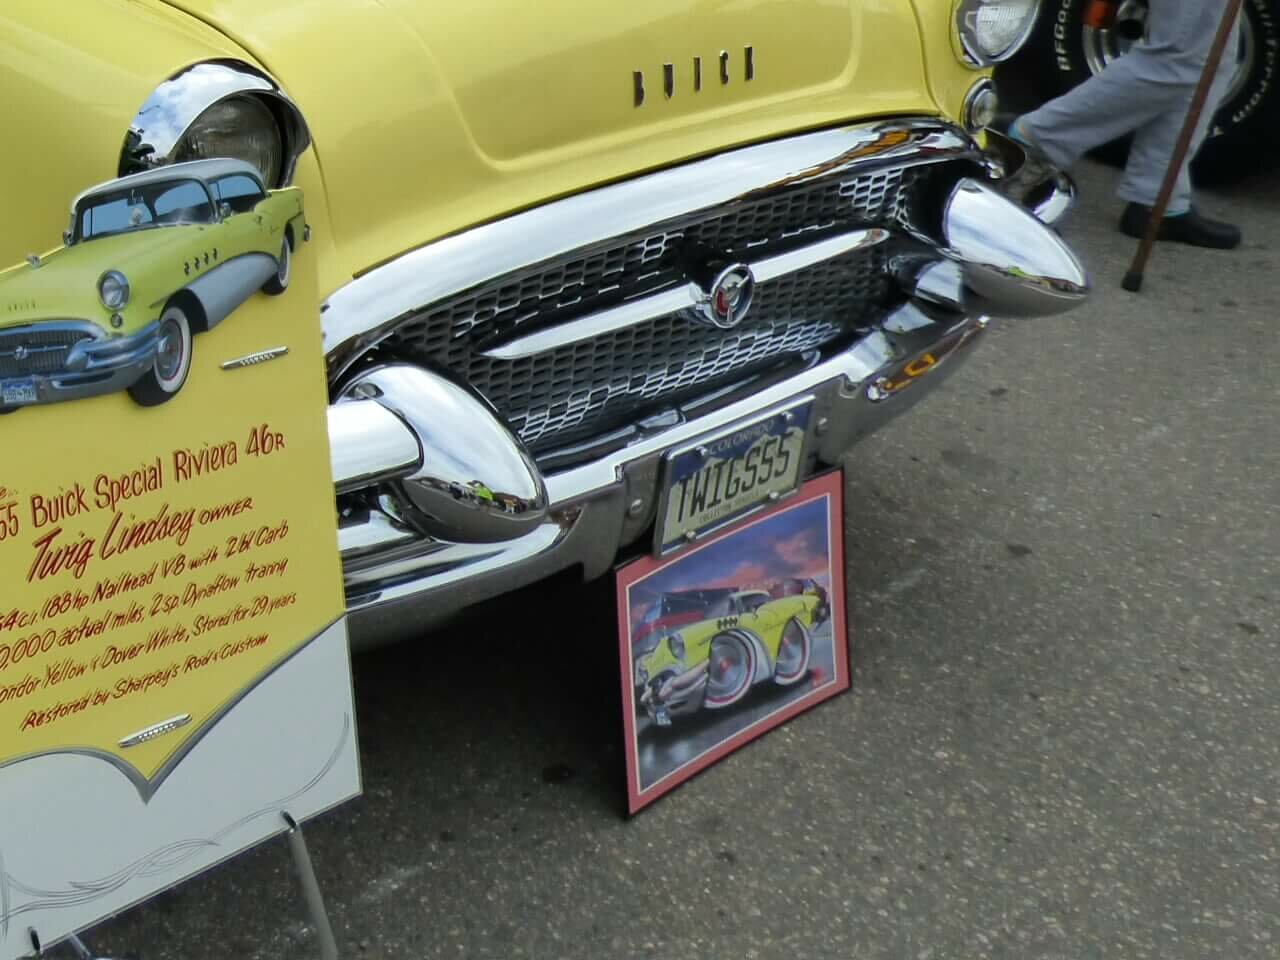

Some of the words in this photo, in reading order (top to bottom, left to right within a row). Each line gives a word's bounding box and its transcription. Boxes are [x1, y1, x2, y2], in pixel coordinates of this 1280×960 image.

[632, 43, 754, 109] BUICK
[708, 418, 776, 456] COLORADO
[30, 482, 90, 529] Buick
[94, 456, 163, 513] Special
[172, 440, 238, 484] Riviera
[27, 526, 96, 584] Twig
[99, 502, 196, 561] Lindsey
[198, 495, 254, 526] OWNER
[90, 560, 159, 606] Nailhead
[161, 553, 187, 579] V8
[189, 544, 219, 571] with
[254, 523, 289, 548] Carb
[42, 657, 88, 689] Yellow
[100, 641, 145, 670] Dover
[145, 621, 190, 655] White,
[191, 607, 234, 638] Stored
[232, 604, 251, 625] for
[249, 594, 270, 619] 29
[267, 591, 298, 617] years
[57, 608, 113, 648] actual
[182, 572, 241, 608] Dynaflow
[244, 557, 289, 583] tranny
[18, 689, 93, 732] Restored
[91, 687, 111, 707] by
[218, 633, 270, 662] Custom
